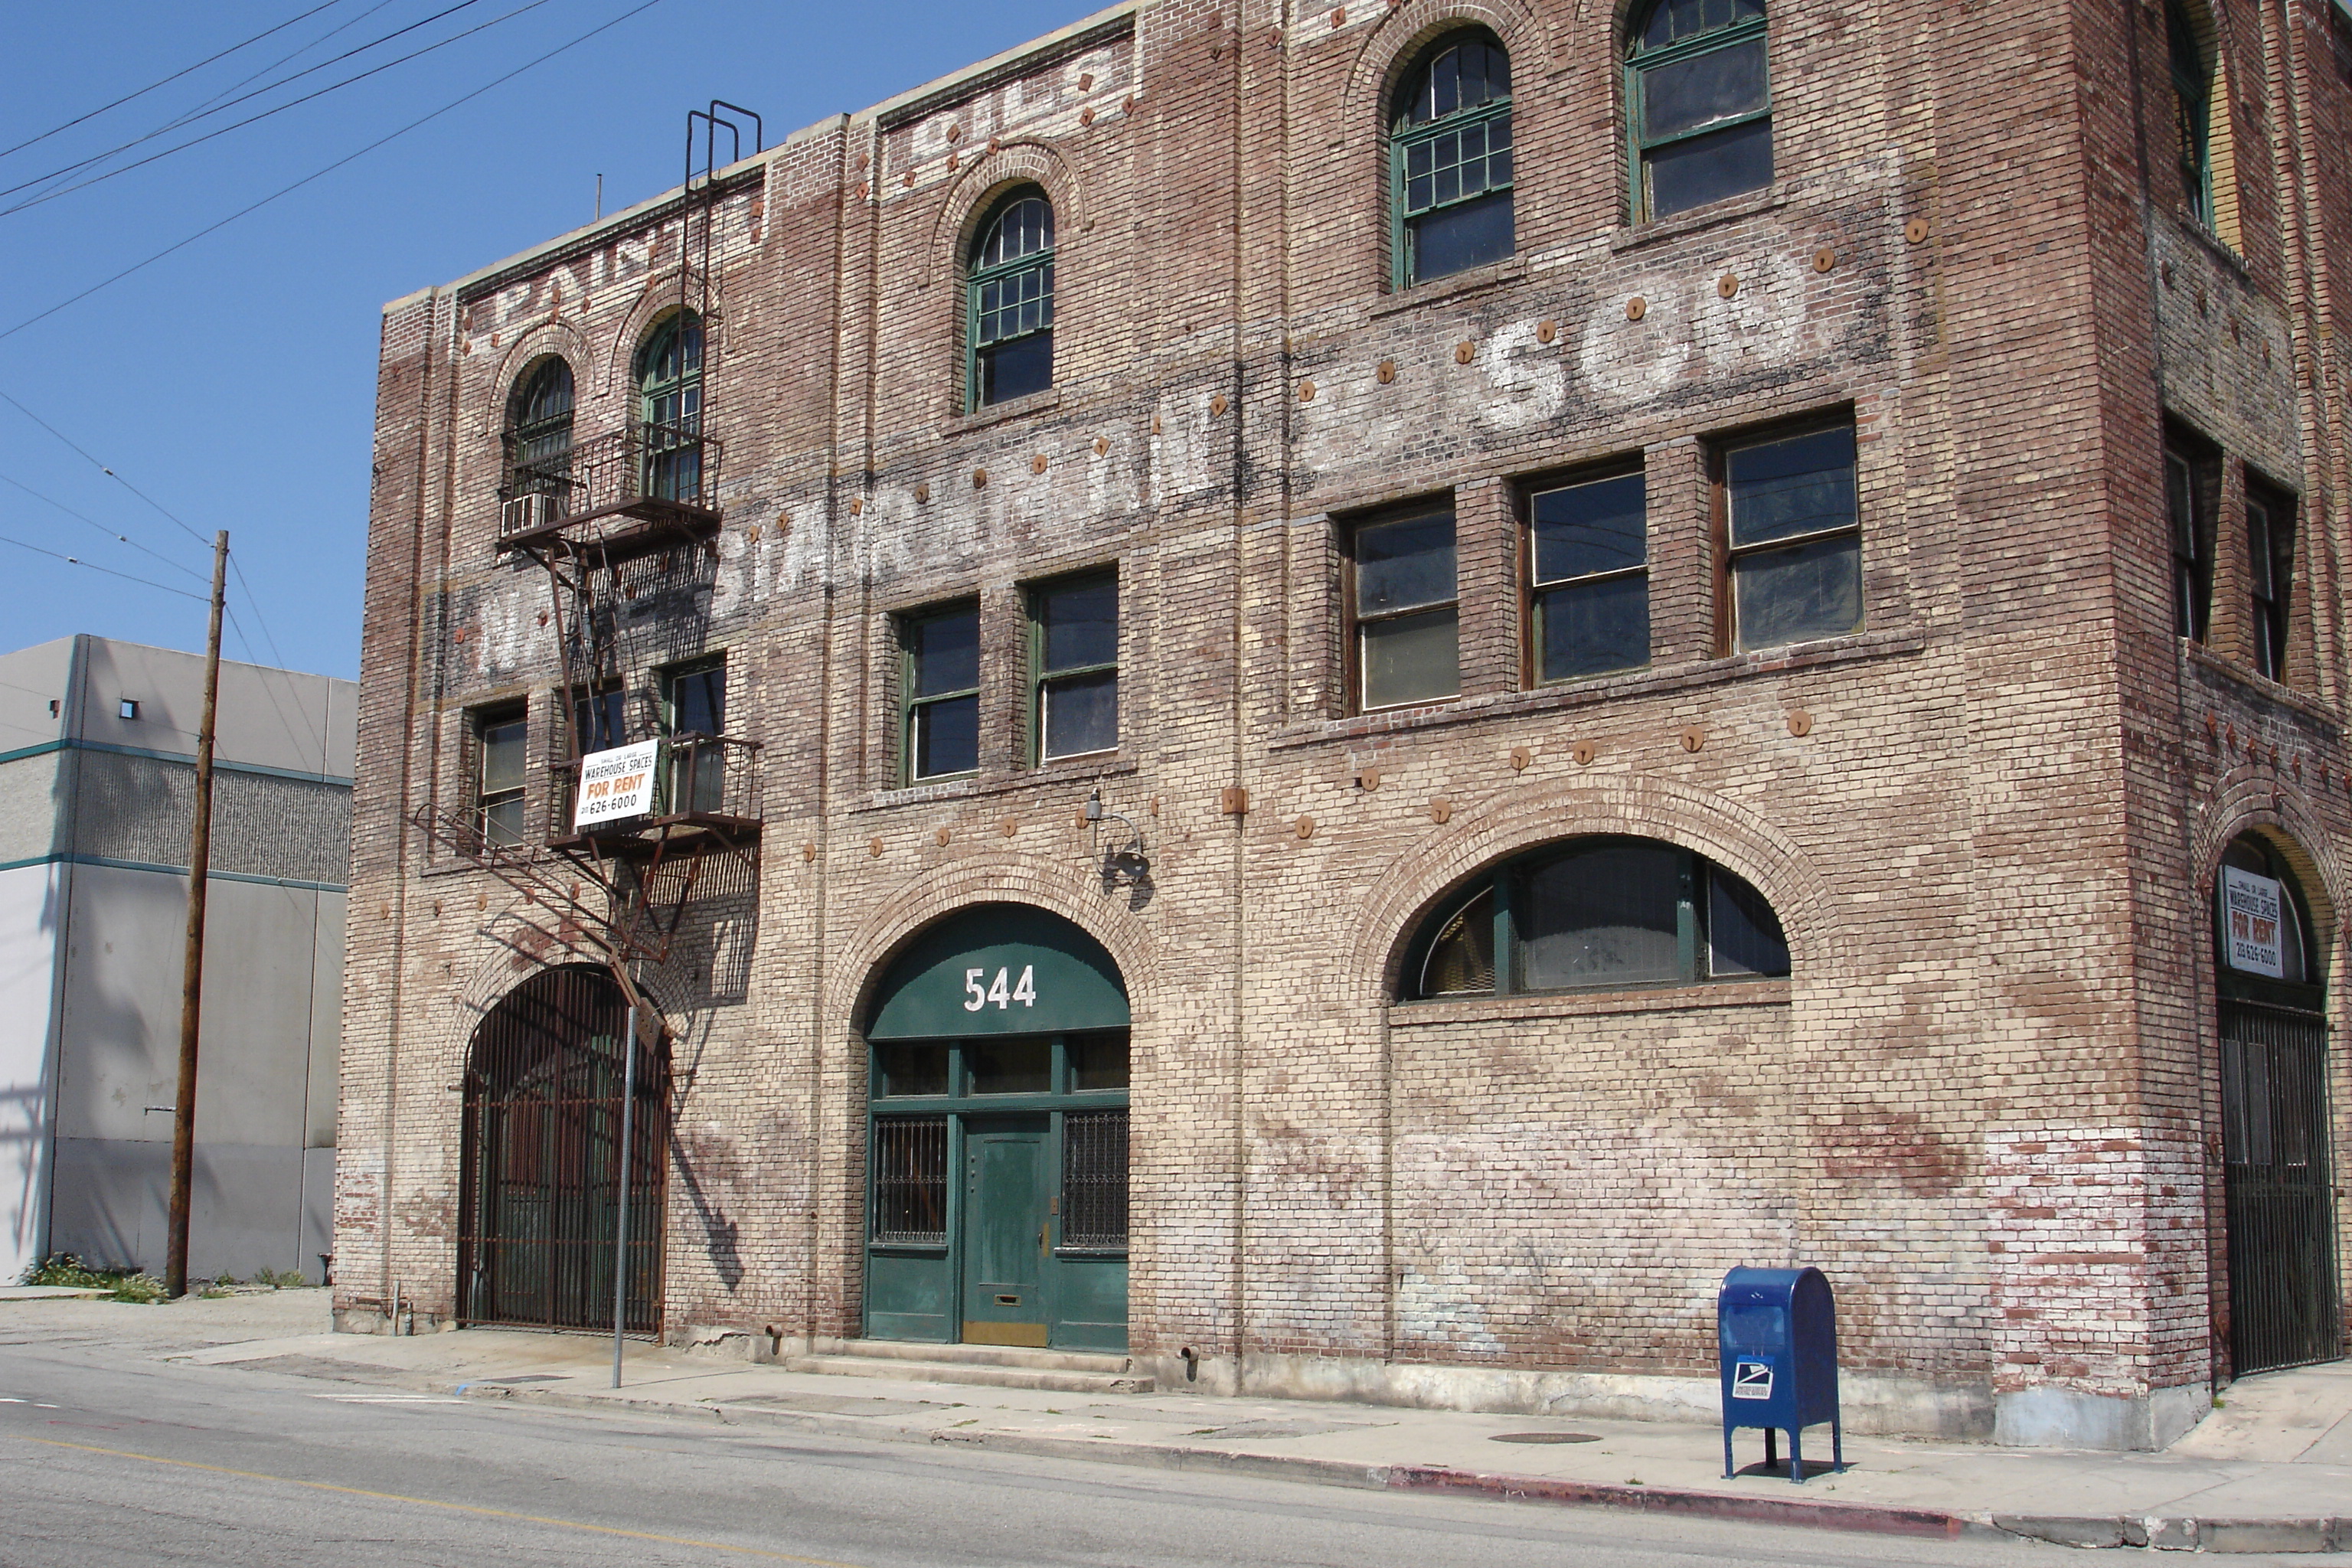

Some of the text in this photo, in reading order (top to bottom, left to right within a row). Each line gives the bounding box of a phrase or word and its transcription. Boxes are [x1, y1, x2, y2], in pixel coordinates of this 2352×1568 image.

[585, 755, 652, 779] WAREHOUSE SPACES
[586, 773, 645, 800] FOR RENT
[590, 794, 637, 814] 626-6000
[2230, 890, 2278, 918] WAREHOUSE SPACES
[2233, 910, 2275, 946] FOR RENT
[2247, 944, 2276, 966] 626-6000
[964, 965, 1037, 1011] 544
